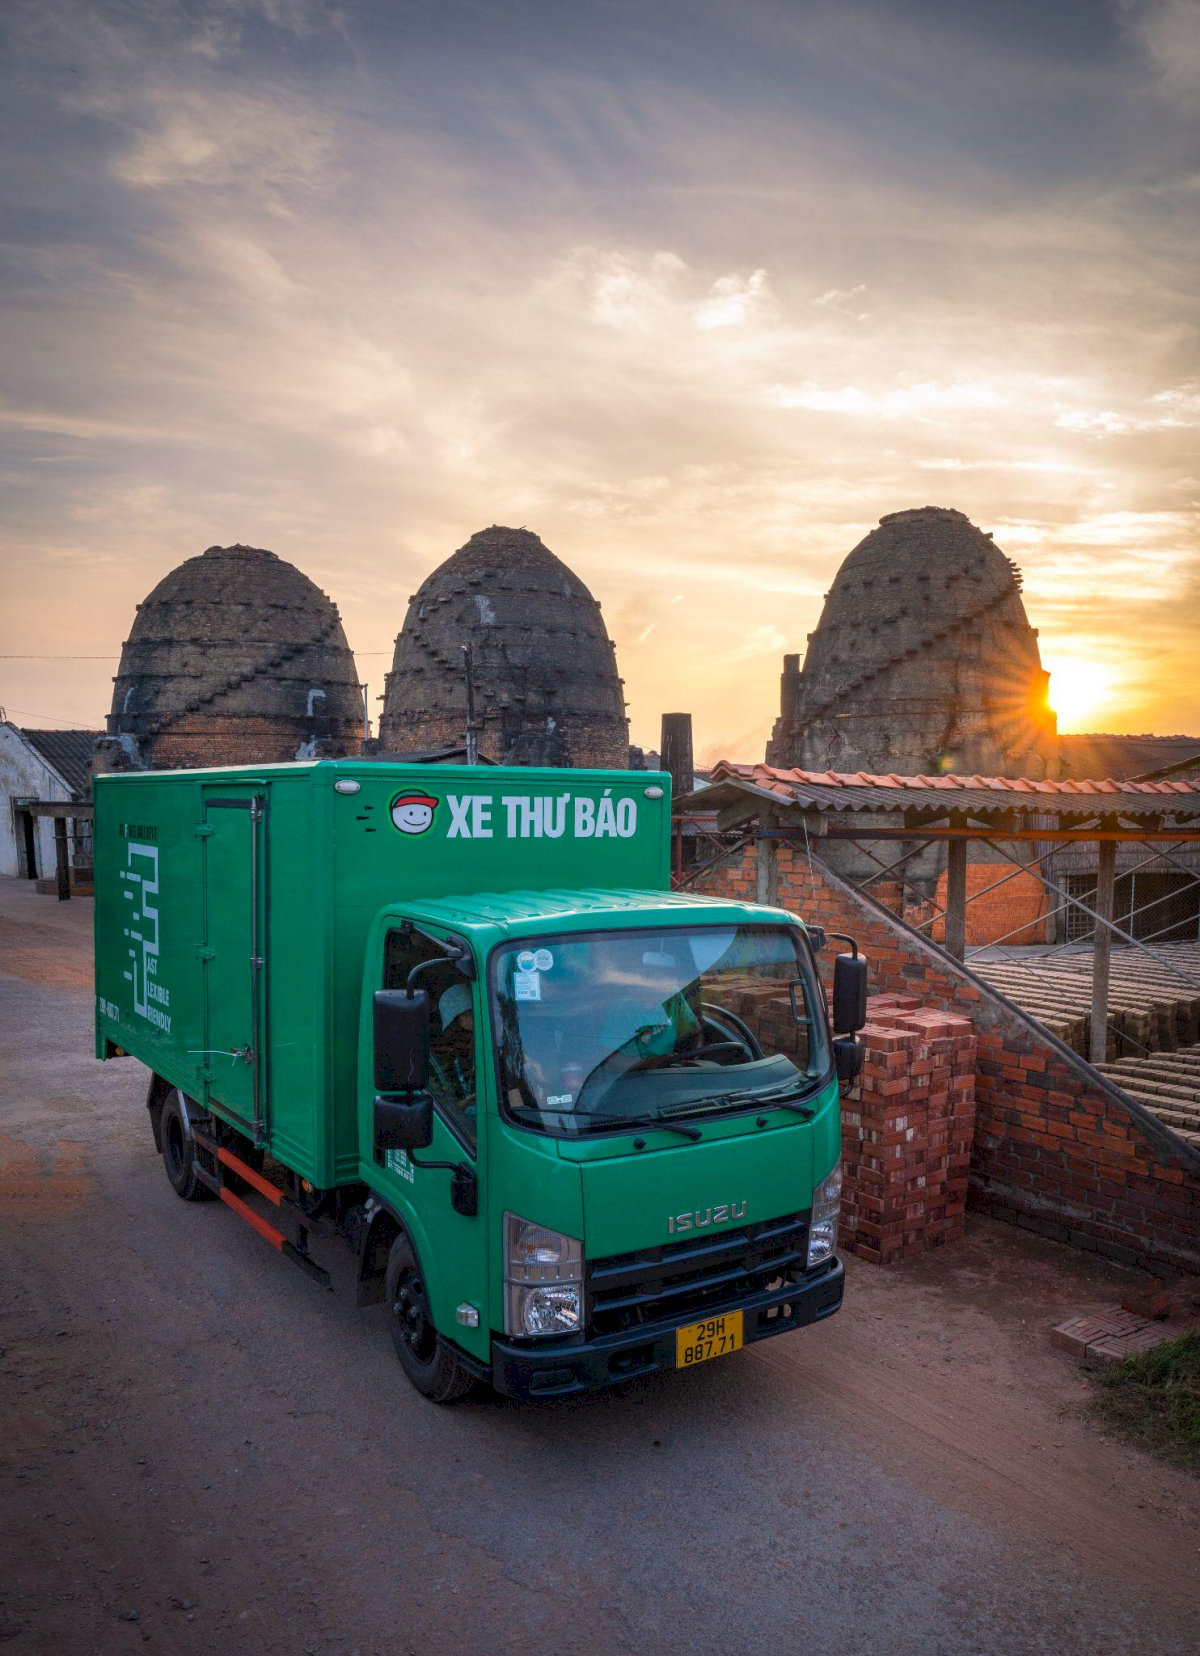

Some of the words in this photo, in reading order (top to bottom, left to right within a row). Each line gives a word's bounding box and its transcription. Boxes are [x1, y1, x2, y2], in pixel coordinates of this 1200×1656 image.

[446, 794, 493, 839] XE
[502, 792, 570, 839] THƯ
[574, 788, 637, 838] BÁO
[147, 956, 158, 976] AST
[147, 1005, 172, 1034] RIENDLY
[668, 1200, 747, 1234] ISUZU
[696, 1318, 725, 1341] 29H
[684, 1334, 735, 1364] 887.71
